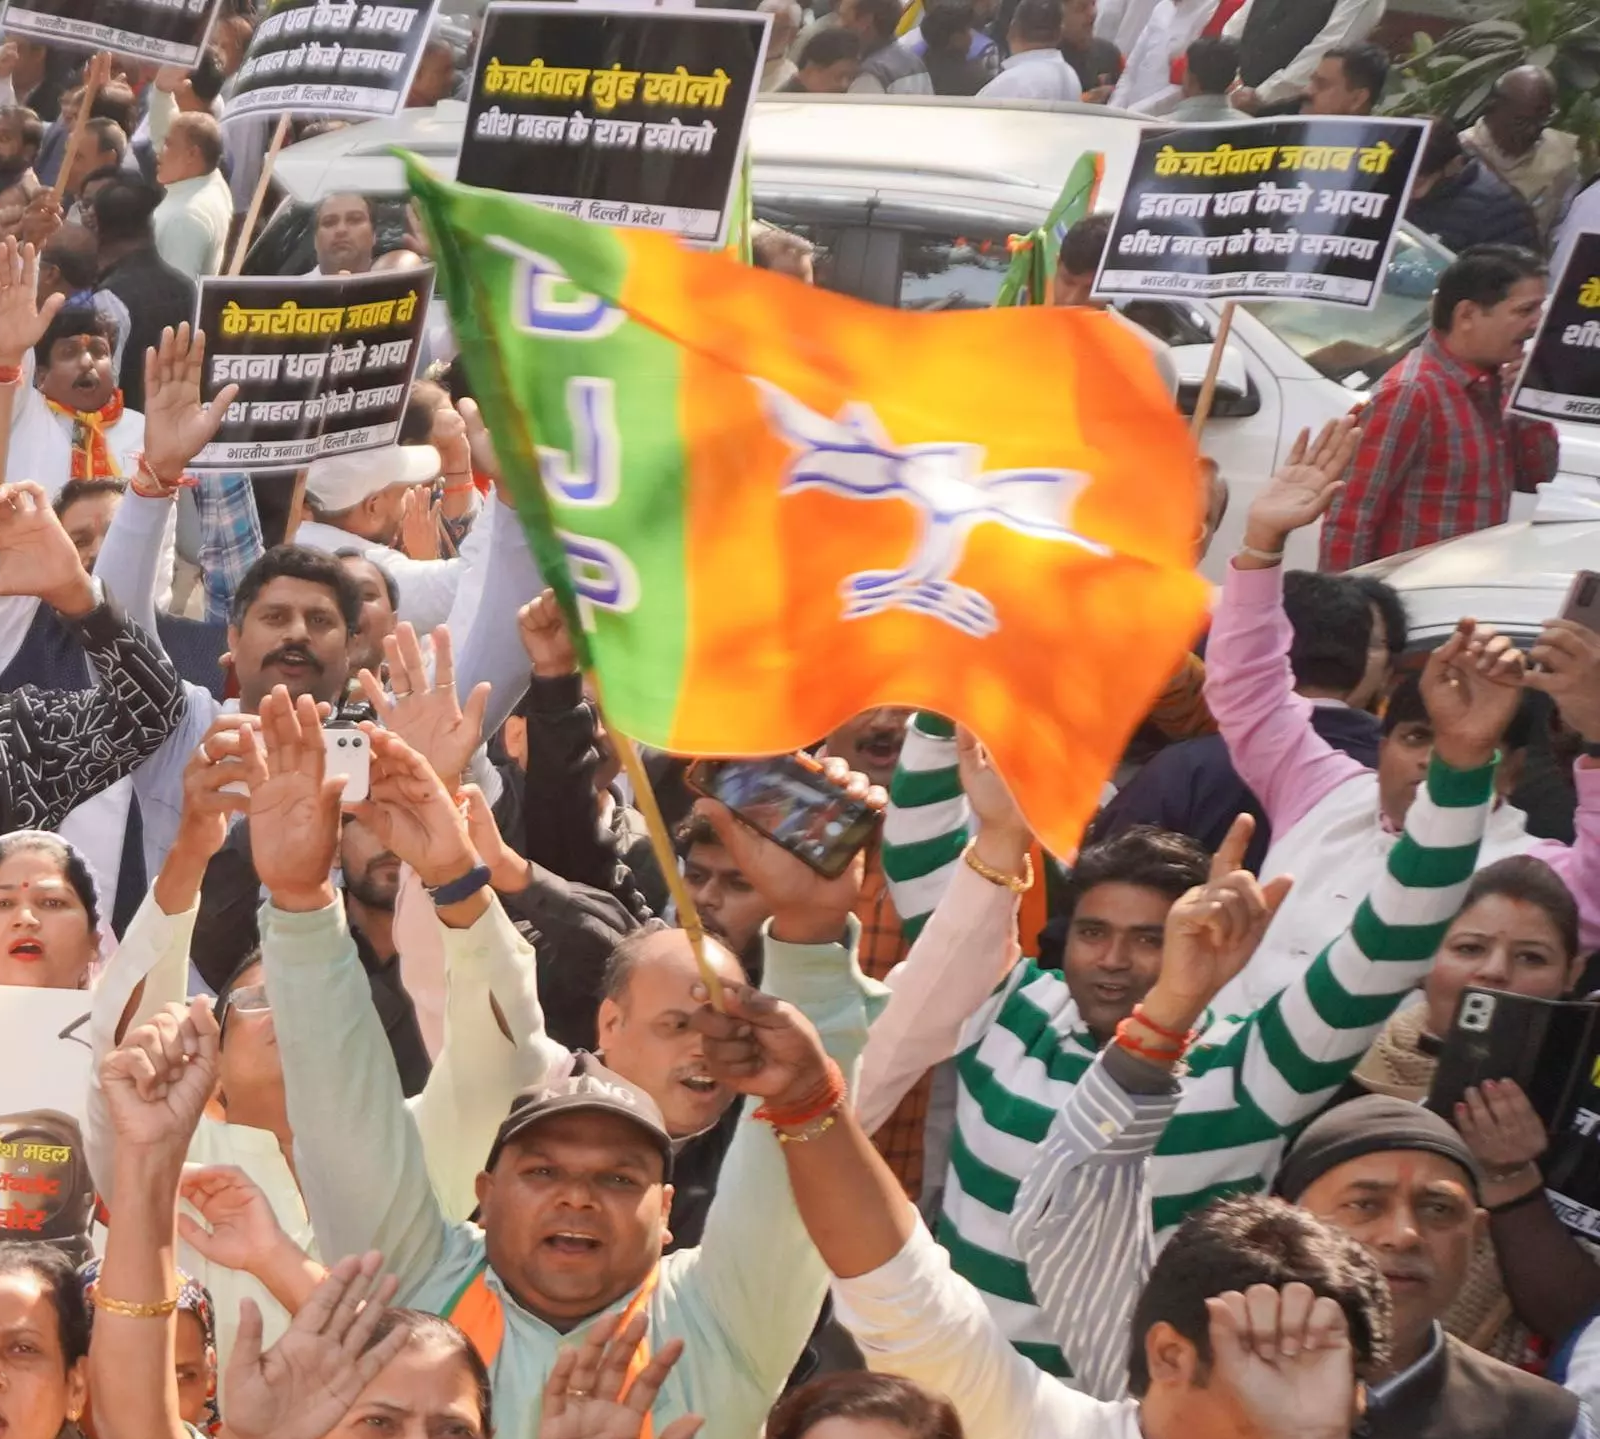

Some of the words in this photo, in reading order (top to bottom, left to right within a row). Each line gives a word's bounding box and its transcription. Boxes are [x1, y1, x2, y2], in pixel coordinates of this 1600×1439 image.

[357, 5, 419, 33] आया
[307, 41, 344, 66] कैसे
[341, 48, 406, 71] सजाया
[301, 86, 331, 101] दिल्ली
[332, 89, 357, 102] प्रदेश
[485, 57, 591, 96] केजरीवाल
[591, 63, 641, 110] मुंह
[643, 65, 731, 107] खोलो
[477, 105, 515, 137] शीश
[517, 113, 568, 141] महल
[568, 110, 594, 143] के
[594, 119, 643, 147] राज
[644, 117, 717, 151] खोलो
[1155, 144, 1278, 177] केजरीवाल
[1278, 145, 1358, 173] जवाब
[1359, 140, 1394, 174] दो
[588, 201, 629, 223] दिल्ली
[631, 209, 665, 226] प्रदेश
[1136, 192, 1214, 220] इतना
[1214, 191, 1256, 216] धन
[1256, 181, 1315, 214] कैसे
[1315, 188, 1390, 219] आया
[1118, 229, 1172, 255] शीश
[1171, 235, 1227, 258] महल
[1227, 228, 1253, 255] को
[1253, 228, 1300, 255] कैसे
[1300, 235, 1379, 260] सजाया
[222, 301, 346, 335] केजरीवाल
[347, 299, 396, 330] जवाब
[397, 290, 418, 322] दो
[212, 354, 283, 382] इतना
[286, 353, 329, 379] धन
[329, 339, 366, 375] कैसे
[366, 338, 413, 368] आया
[251, 400, 304, 421] महल
[305, 393, 326, 419] को
[326, 388, 355, 415] कैसे
[355, 384, 405, 409] सजाया
[227, 443, 270, 459] भारतीय
[273, 444, 302, 458] जनता
[22, 1143, 72, 1163] महल
